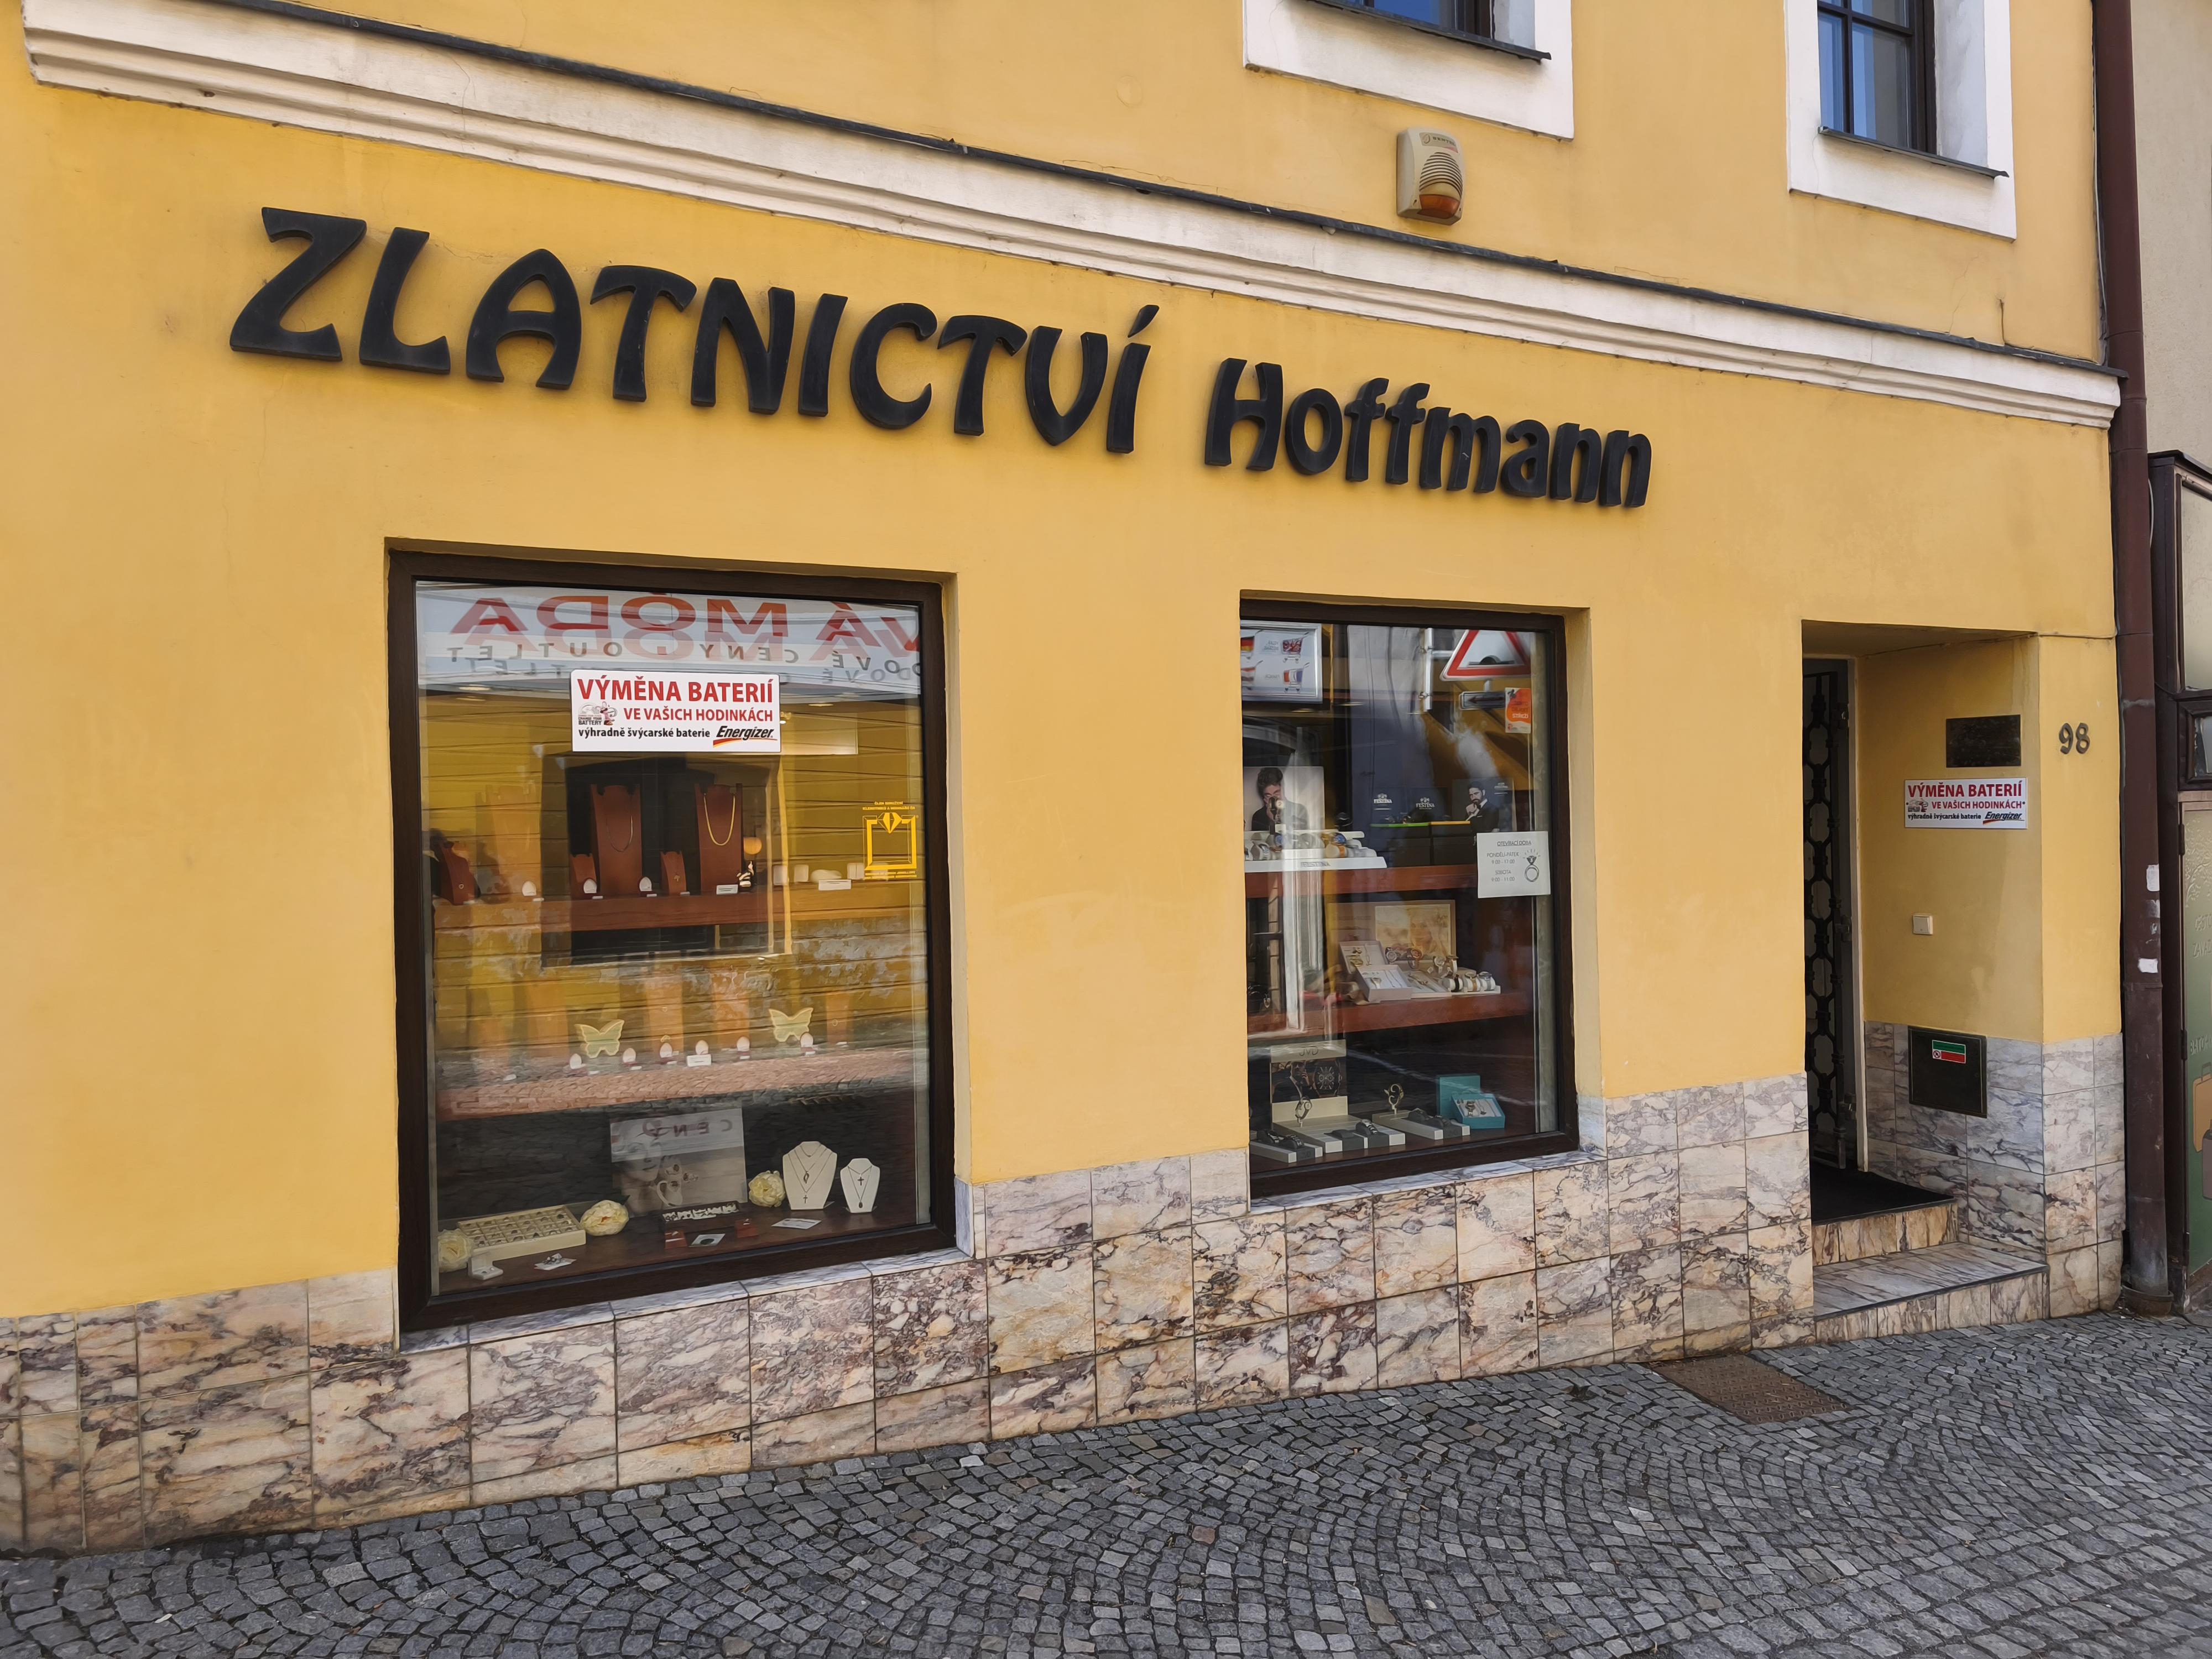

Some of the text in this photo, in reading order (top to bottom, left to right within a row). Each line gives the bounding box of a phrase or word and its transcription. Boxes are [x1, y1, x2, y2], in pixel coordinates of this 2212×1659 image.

[229, 207, 1652, 508] ZLATNICTVÍ Hoffmann
[577, 675, 774, 703] VÝMĚNA BATERIÍ
[623, 706, 773, 722] VE VAŠICH HODINKÁCH
[578, 726, 773, 740] výhradně švýcarské baterie Energizer
[2058, 723, 2090, 755] 98
[1908, 780, 2022, 797] VÝMĚNA BATERIÍ
[1943, 800, 1970, 809] VAŠICH
[1973, 799, 2022, 809] HODINKÁCH
[1985, 811, 2021, 821] Energizer
[1300, 1046, 1319, 1056] JVD
